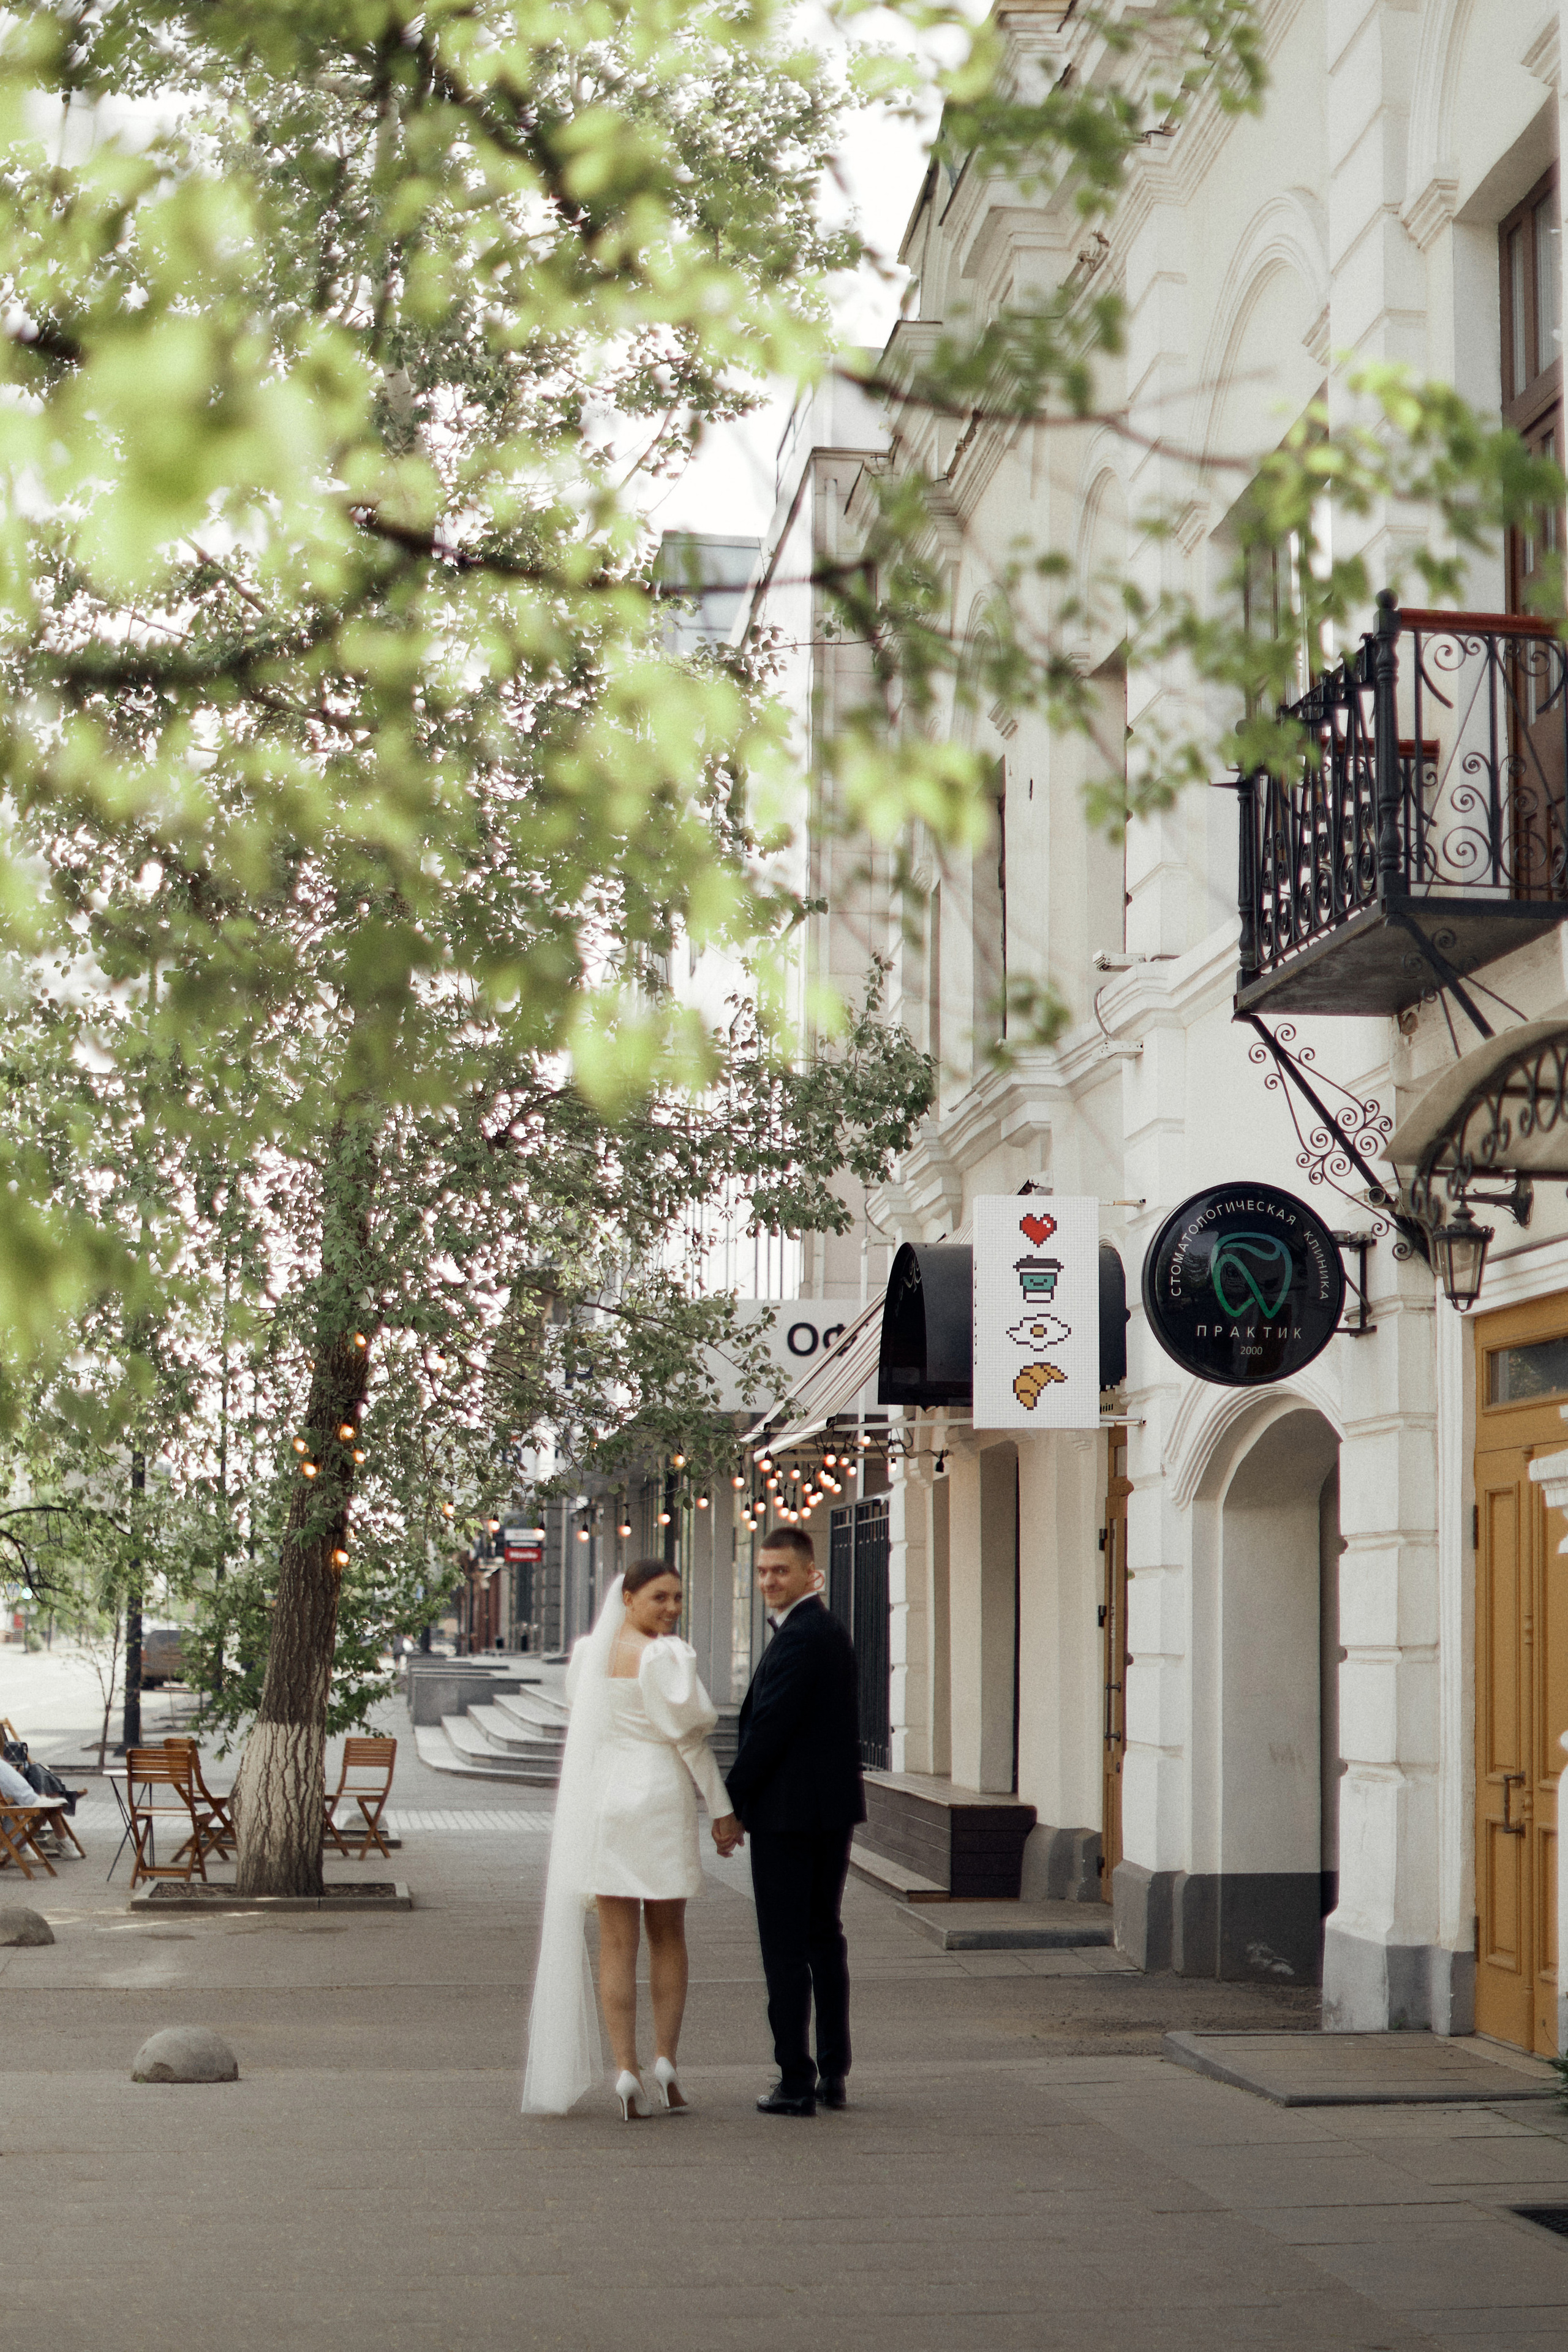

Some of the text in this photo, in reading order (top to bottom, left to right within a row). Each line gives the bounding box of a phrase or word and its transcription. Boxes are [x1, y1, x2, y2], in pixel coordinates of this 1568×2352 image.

[1170, 1200, 1330, 1300] СТОМАТОЛОГИЧЕСКАЯ КЛИНИКА
[787, 1322, 869, 1357] ОФ
[1196, 1325, 1302, 1340] ПРАКТИК
[1240, 1346, 1264, 1355] 2000
